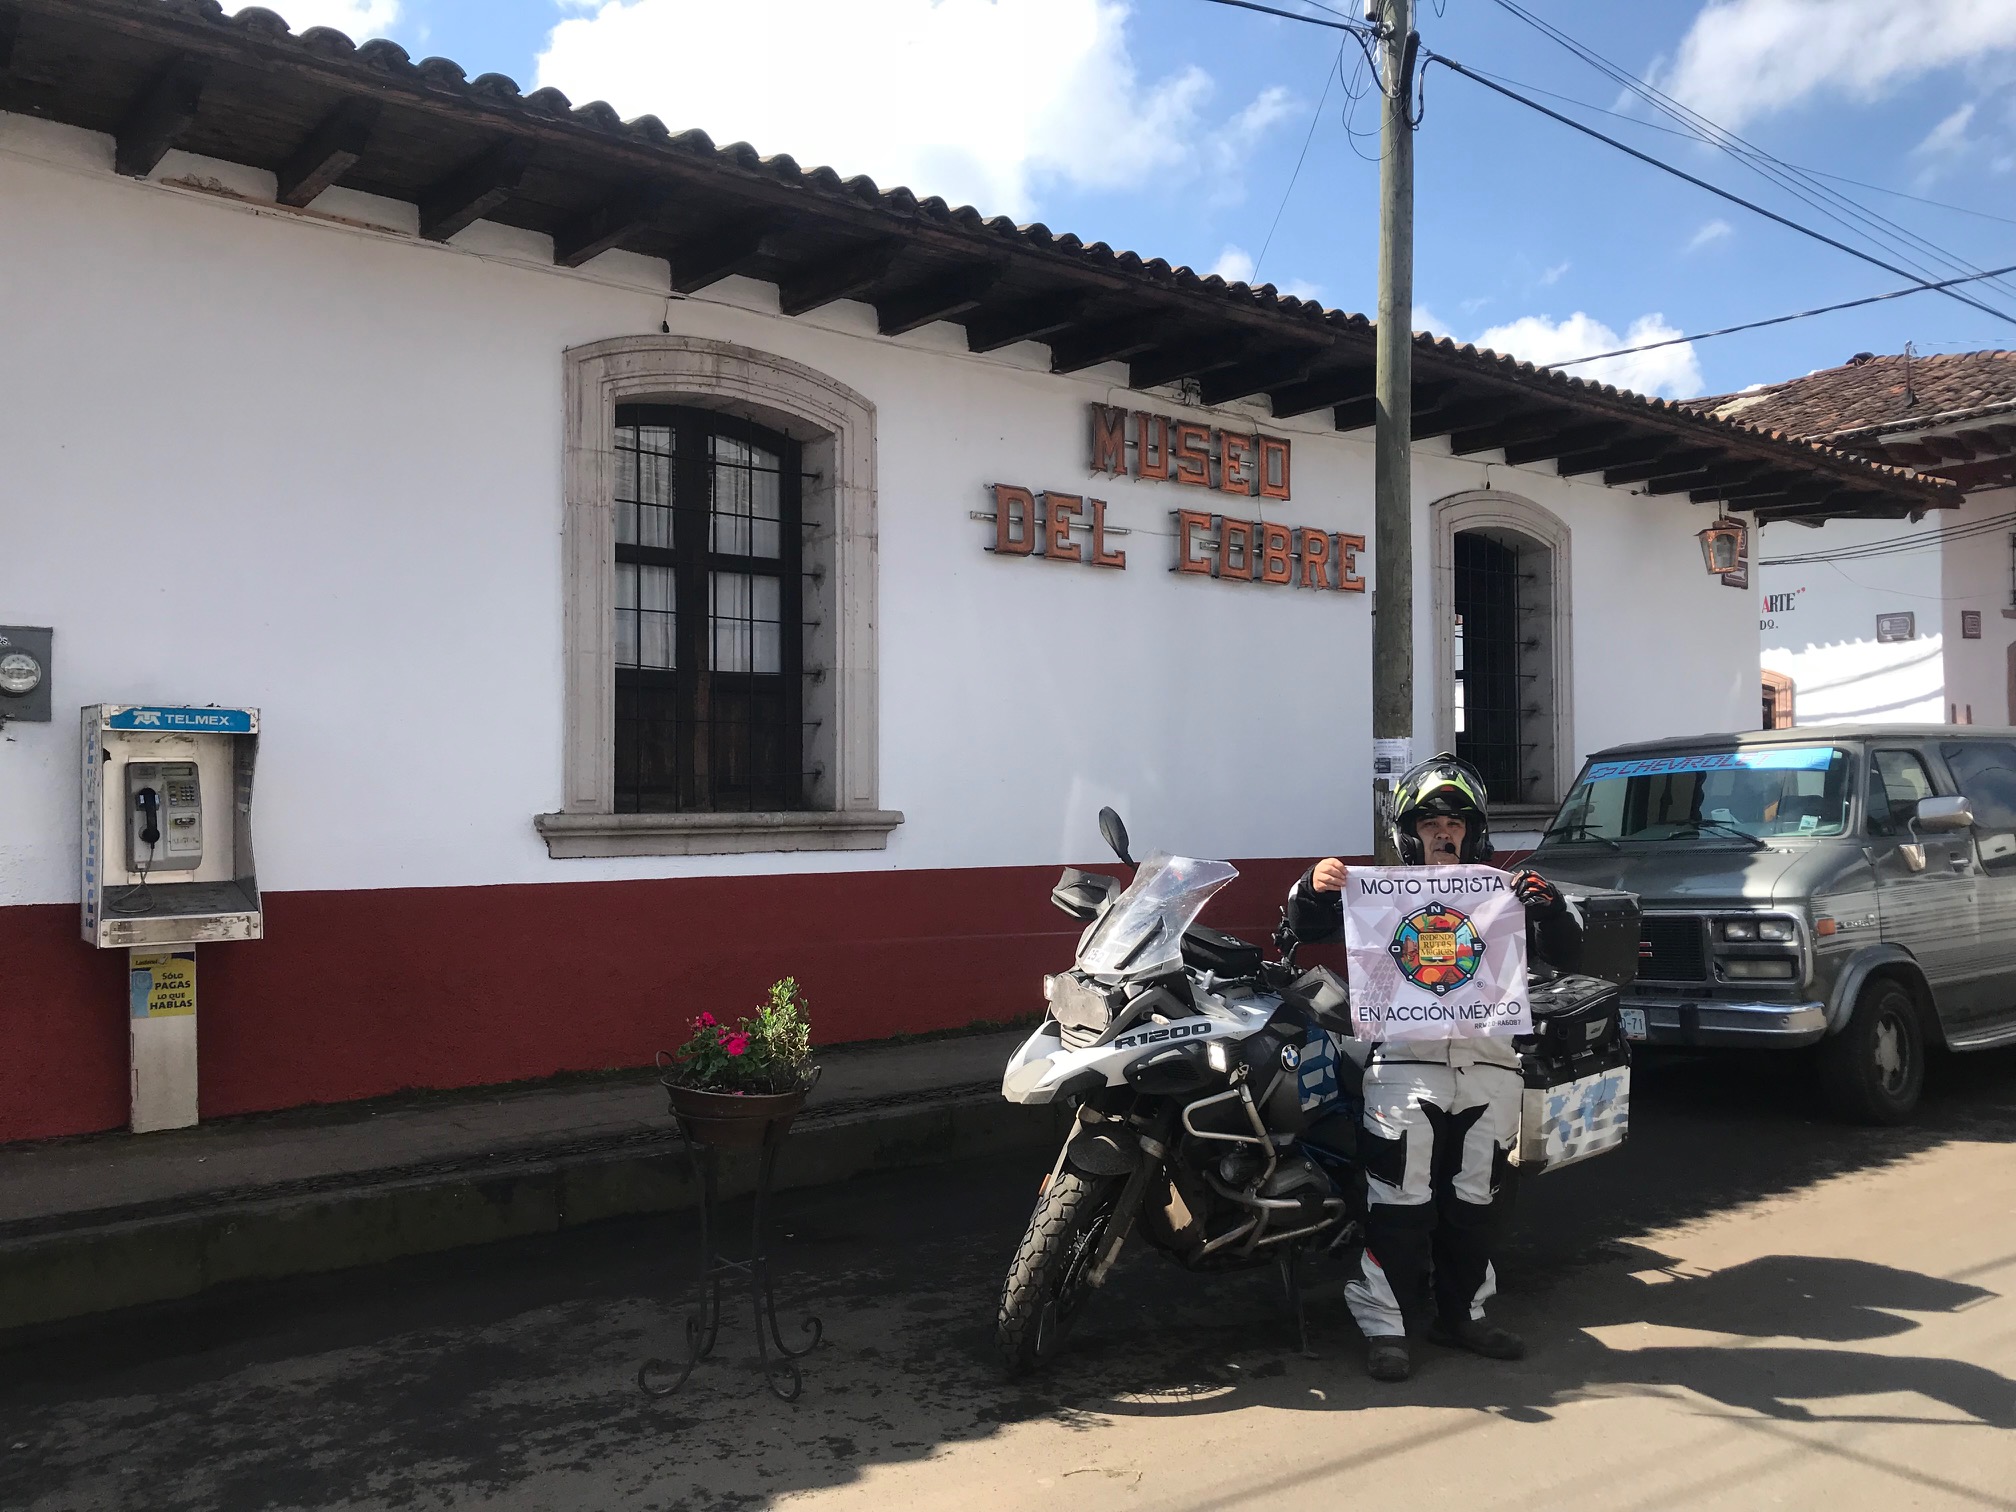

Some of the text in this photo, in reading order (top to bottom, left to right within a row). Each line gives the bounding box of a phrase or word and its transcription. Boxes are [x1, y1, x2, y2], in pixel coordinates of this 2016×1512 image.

[1090, 401, 1291, 501] MUSEO
[994, 482, 1366, 594] DEL COBRE
[164, 714, 230, 726] TELMEX
[1618, 752, 1777, 776] CHEVROLET
[1360, 875, 1506, 895] MOTO TURISTA
[1430, 905, 1441, 913] N
[1473, 943, 1483, 951] E
[154, 980, 191, 990] PAGAS
[1436, 984, 1446, 992] S
[169, 992, 185, 1000] QUE
[150, 1000, 193, 1010] HABLAS
[1359, 1000, 1522, 1022] EN ACCIÓN MÉXICO
[1114, 1022, 1212, 1051] R1200
